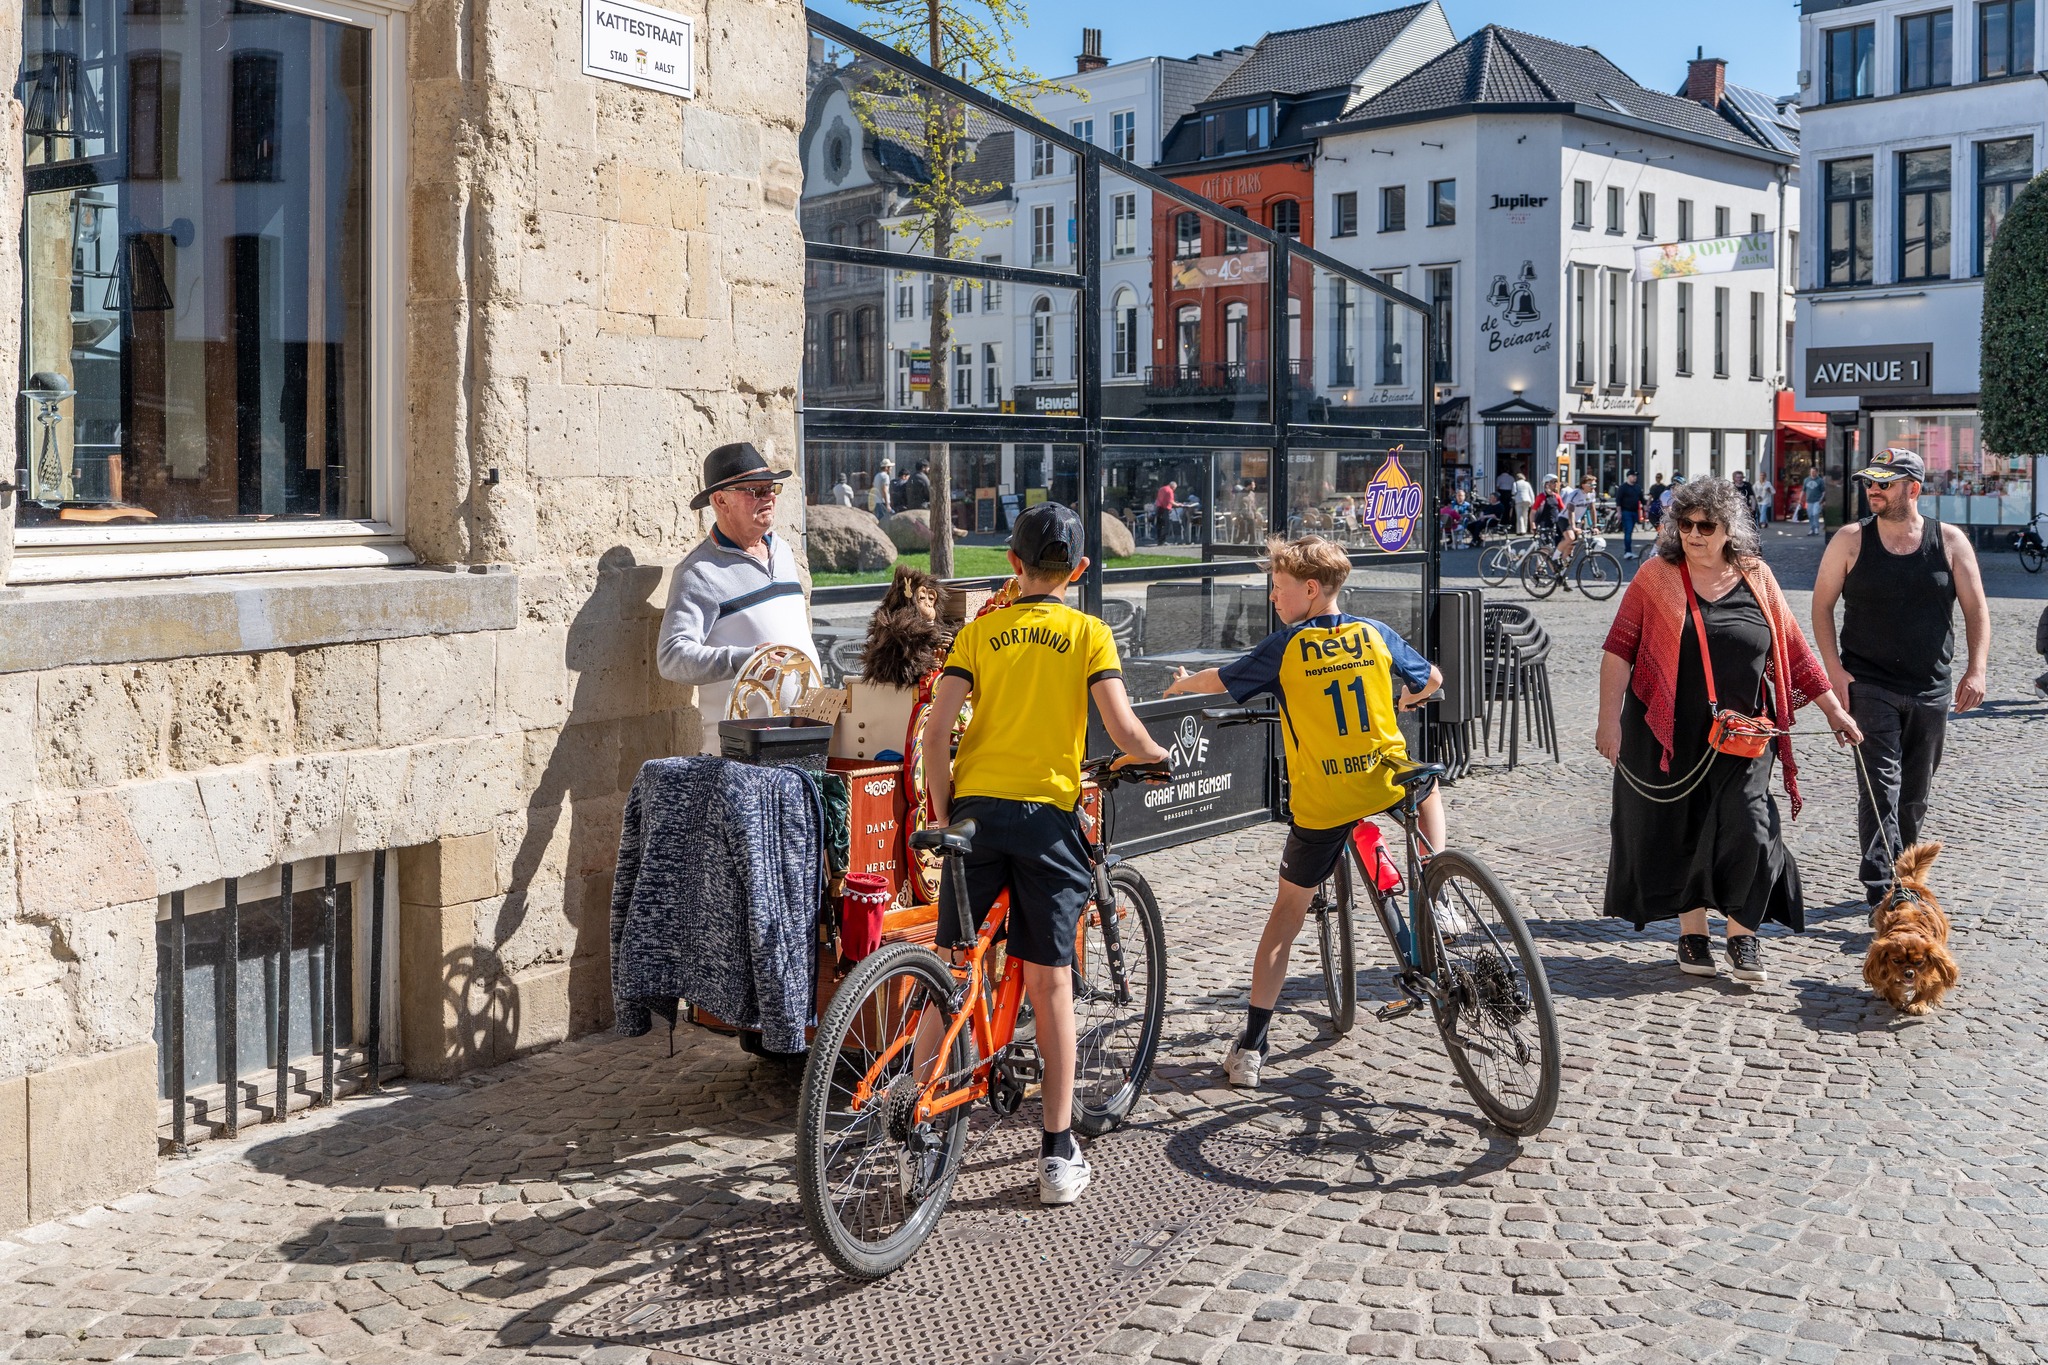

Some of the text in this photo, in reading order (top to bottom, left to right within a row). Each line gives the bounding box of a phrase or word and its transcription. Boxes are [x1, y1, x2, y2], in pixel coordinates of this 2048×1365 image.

[597, 10, 683, 46] KATTESTRAAT
[610, 50, 675, 74] STAD AALST
[1223, 177, 1233, 197] DE
[1237, 172, 1261, 195] PARIS
[1489, 194, 1548, 210] Jupiler
[1741, 253, 1768, 265] aalst
[1481, 315, 1498, 332] de
[1489, 322, 1552, 352] Beiaard
[1814, 361, 1920, 383] AVENUE 1
[1036, 392, 1078, 410] Hawaii
[1369, 389, 1415, 404] de Beiaard
[1366, 483, 1422, 521] TIMO
[1382, 528, 1403, 544] 2027
[989, 627, 1071, 654] DORTMUND
[1300, 628, 1372, 662] hey!
[1305, 659, 1375, 677] heytelecom.be
[1324, 676, 1371, 736] 11
[1174, 772, 1190, 781] ANNO
[1322, 759, 1342, 776] VD.
[1144, 773, 1232, 807] GRAAF VAN EGMONT
[1164, 803, 1213, 821] BRASSERIE CAFÉ
[866, 820, 894, 834] DANK
[878, 840, 885, 849] U
[866, 860, 896, 873] MERCI
